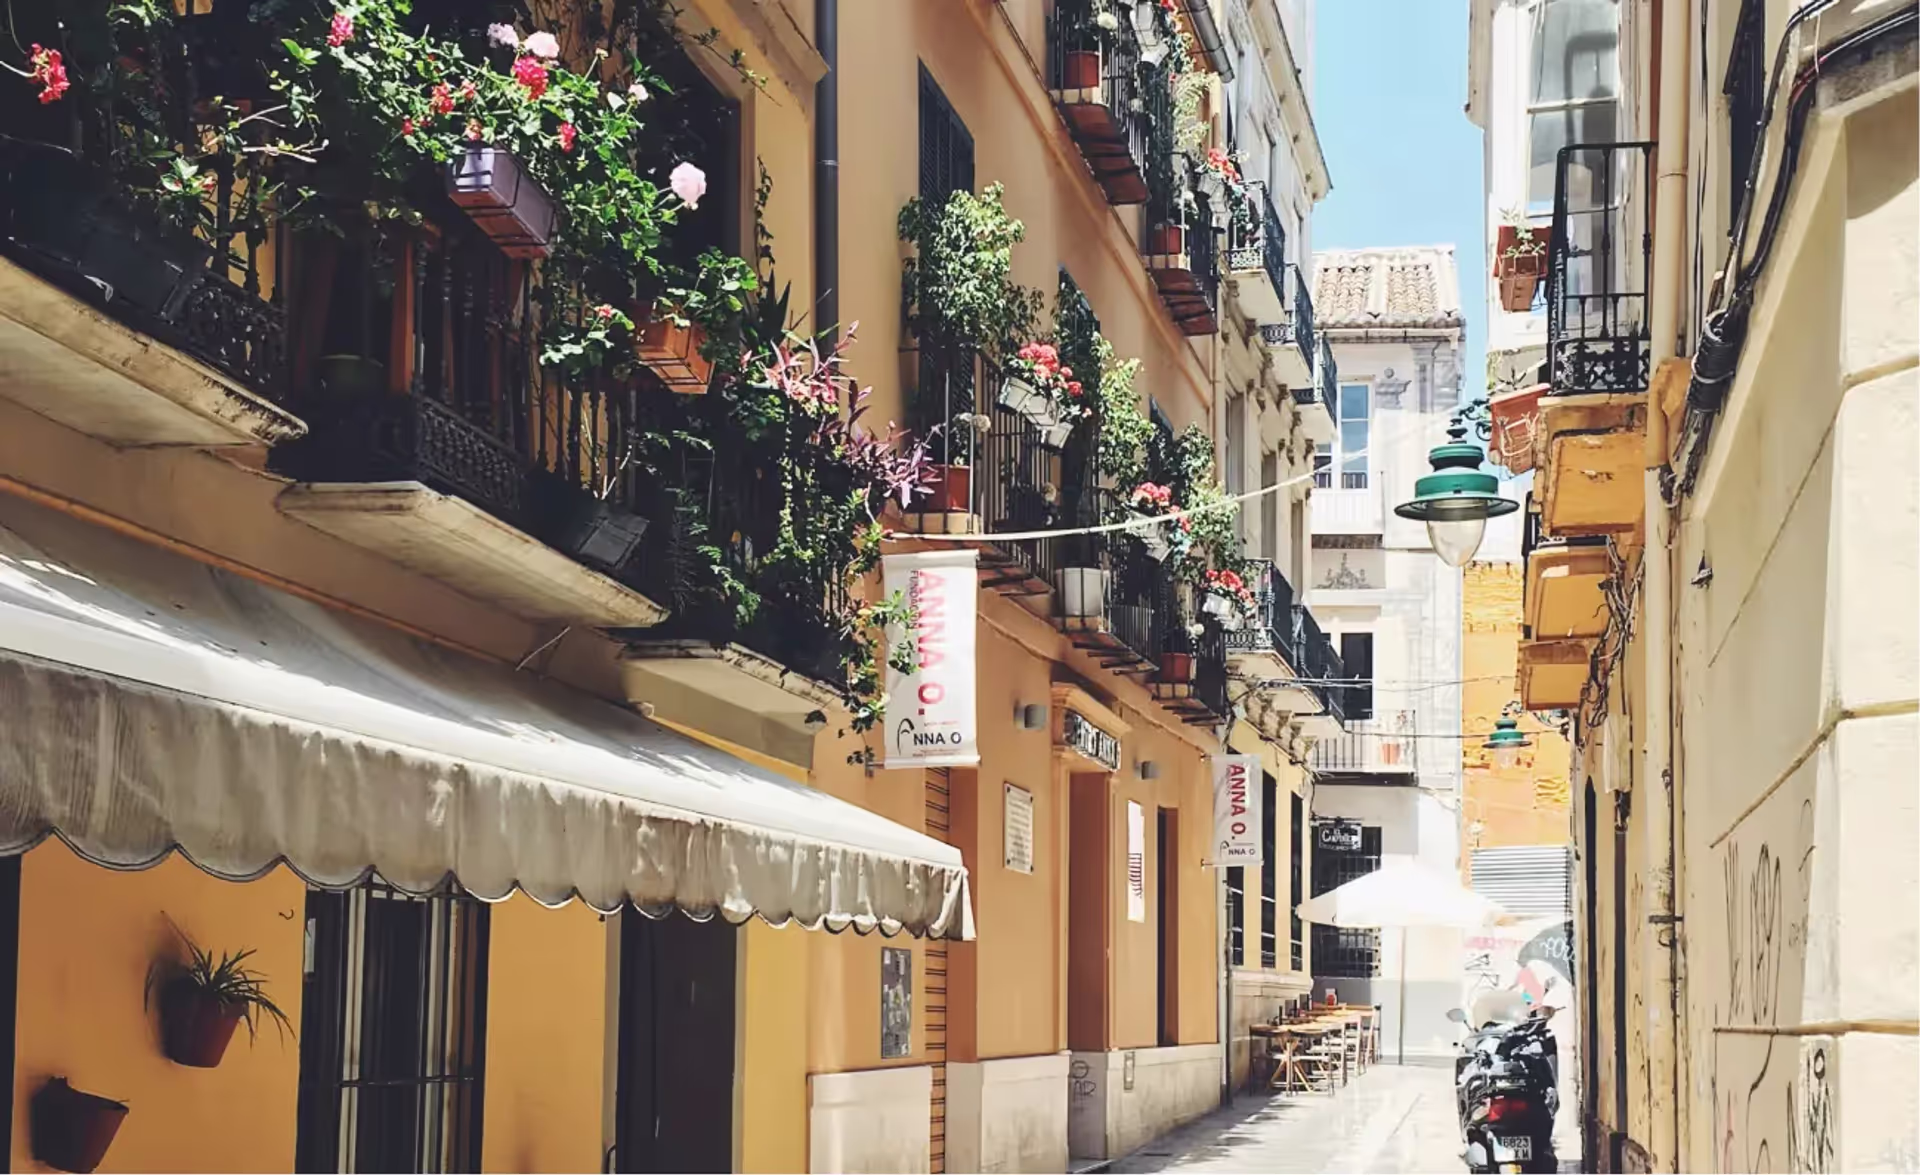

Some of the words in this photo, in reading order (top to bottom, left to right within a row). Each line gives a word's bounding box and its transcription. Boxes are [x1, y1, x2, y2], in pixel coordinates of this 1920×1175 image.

[918, 570, 946, 669] ANNA
[918, 682, 946, 716] O.
[950, 731, 962, 744] O
[1231, 765, 1246, 817] ANNA
